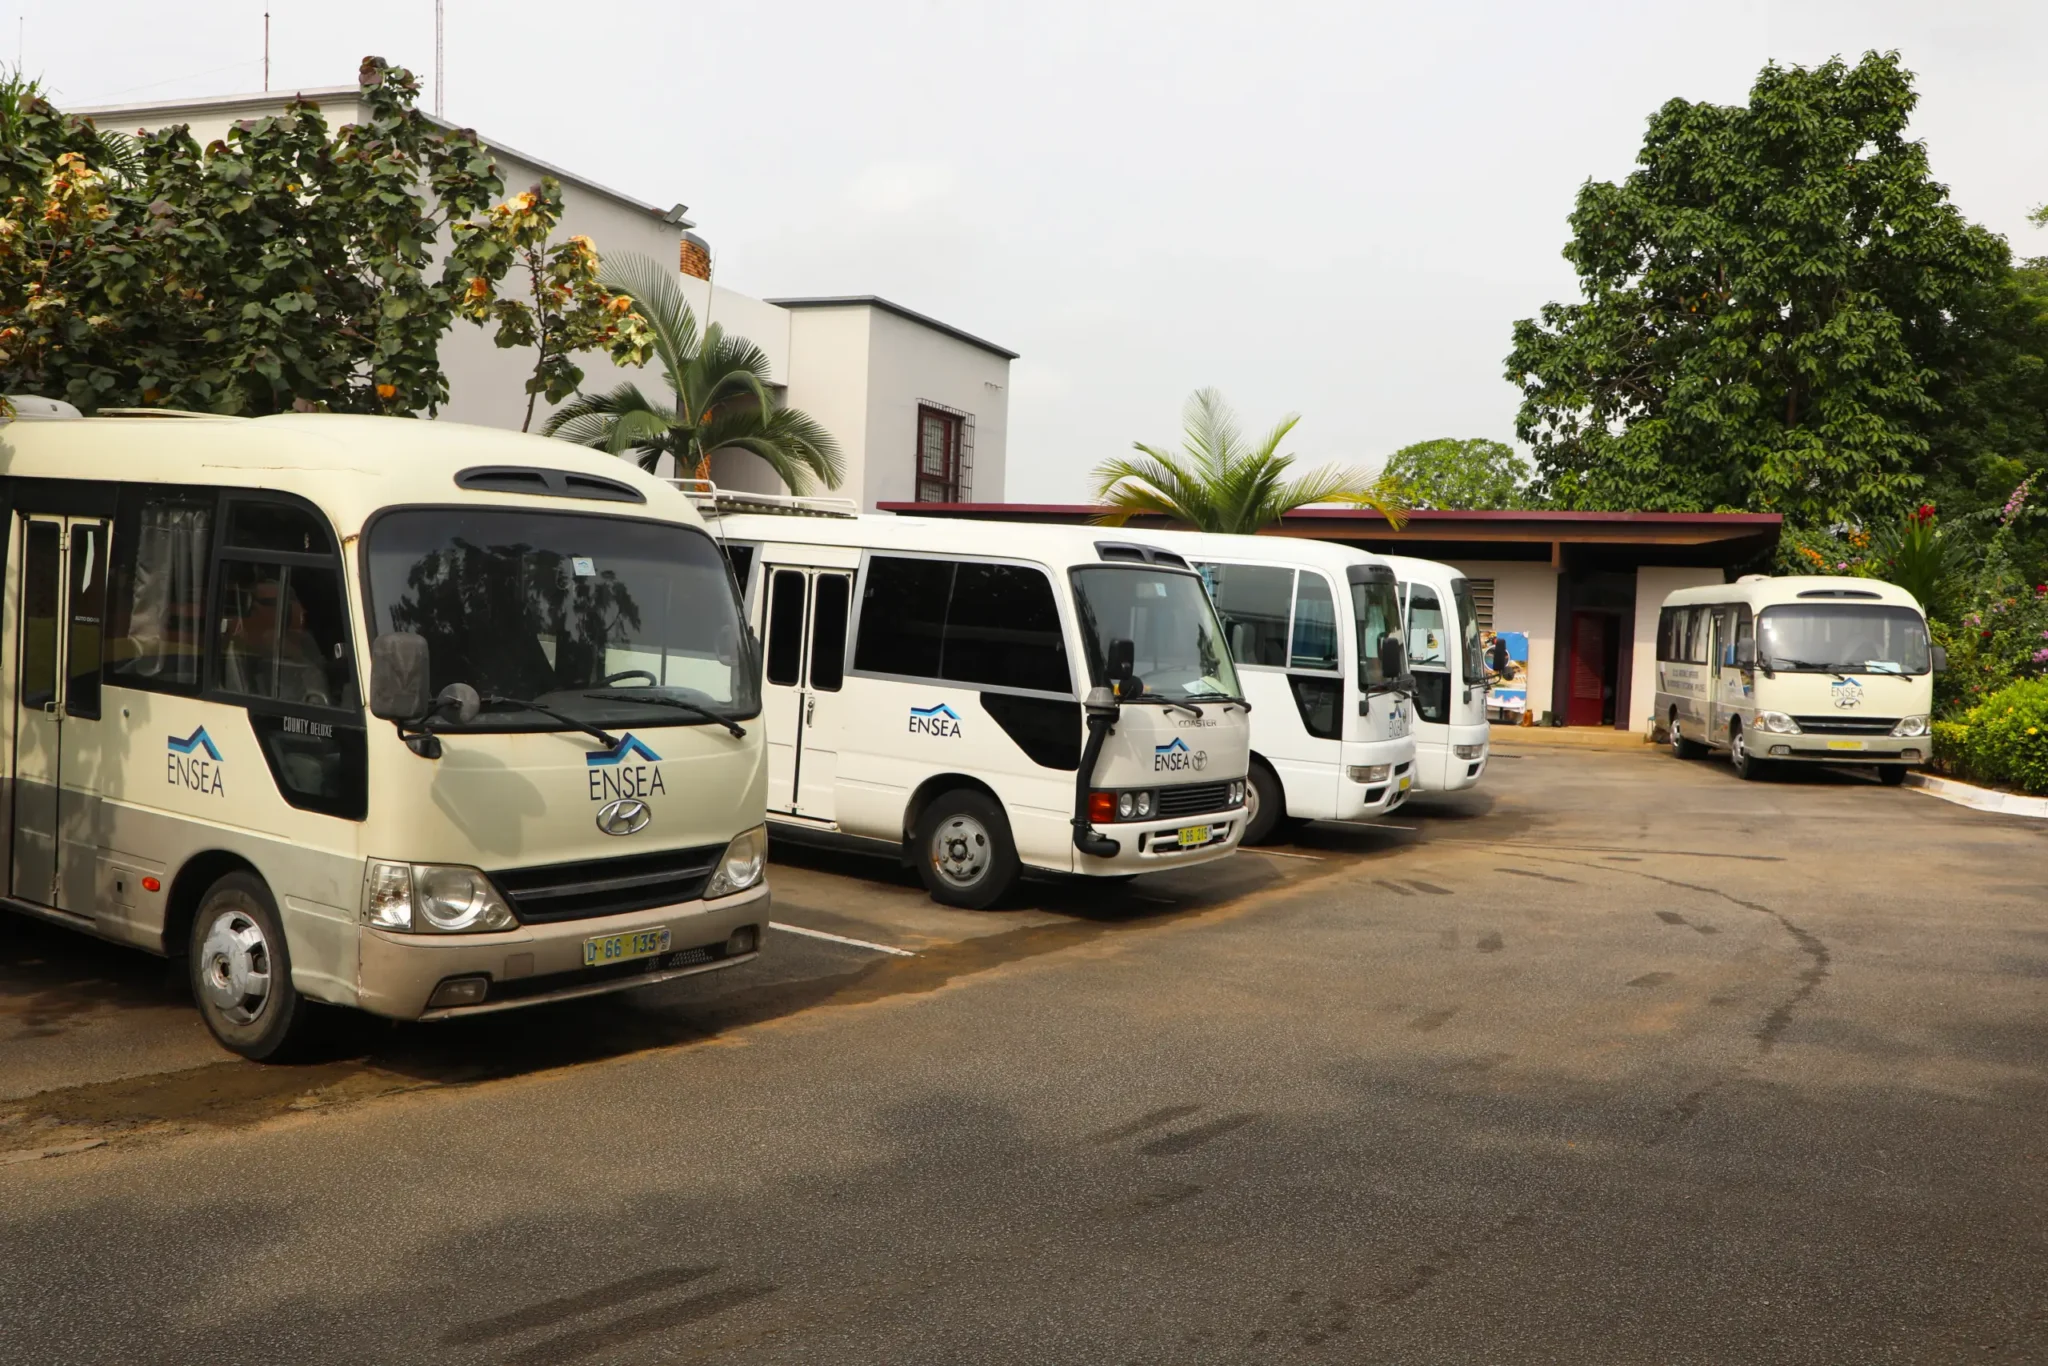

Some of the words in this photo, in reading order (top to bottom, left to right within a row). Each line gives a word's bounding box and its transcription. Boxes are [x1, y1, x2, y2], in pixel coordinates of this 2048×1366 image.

[1831, 686, 1865, 698] ENSEA
[283, 715, 309, 735] COUNTY
[310, 721, 333, 738] DELUXE
[908, 715, 962, 739] ENSEA
[1178, 720, 1217, 729] COASTER
[1154, 752, 1190, 771] ENSEA
[167, 752, 225, 798] ENSEA
[588, 765, 666, 801] ENSEA
[605, 938, 621, 959] 66
[633, 932, 657, 955] 135
